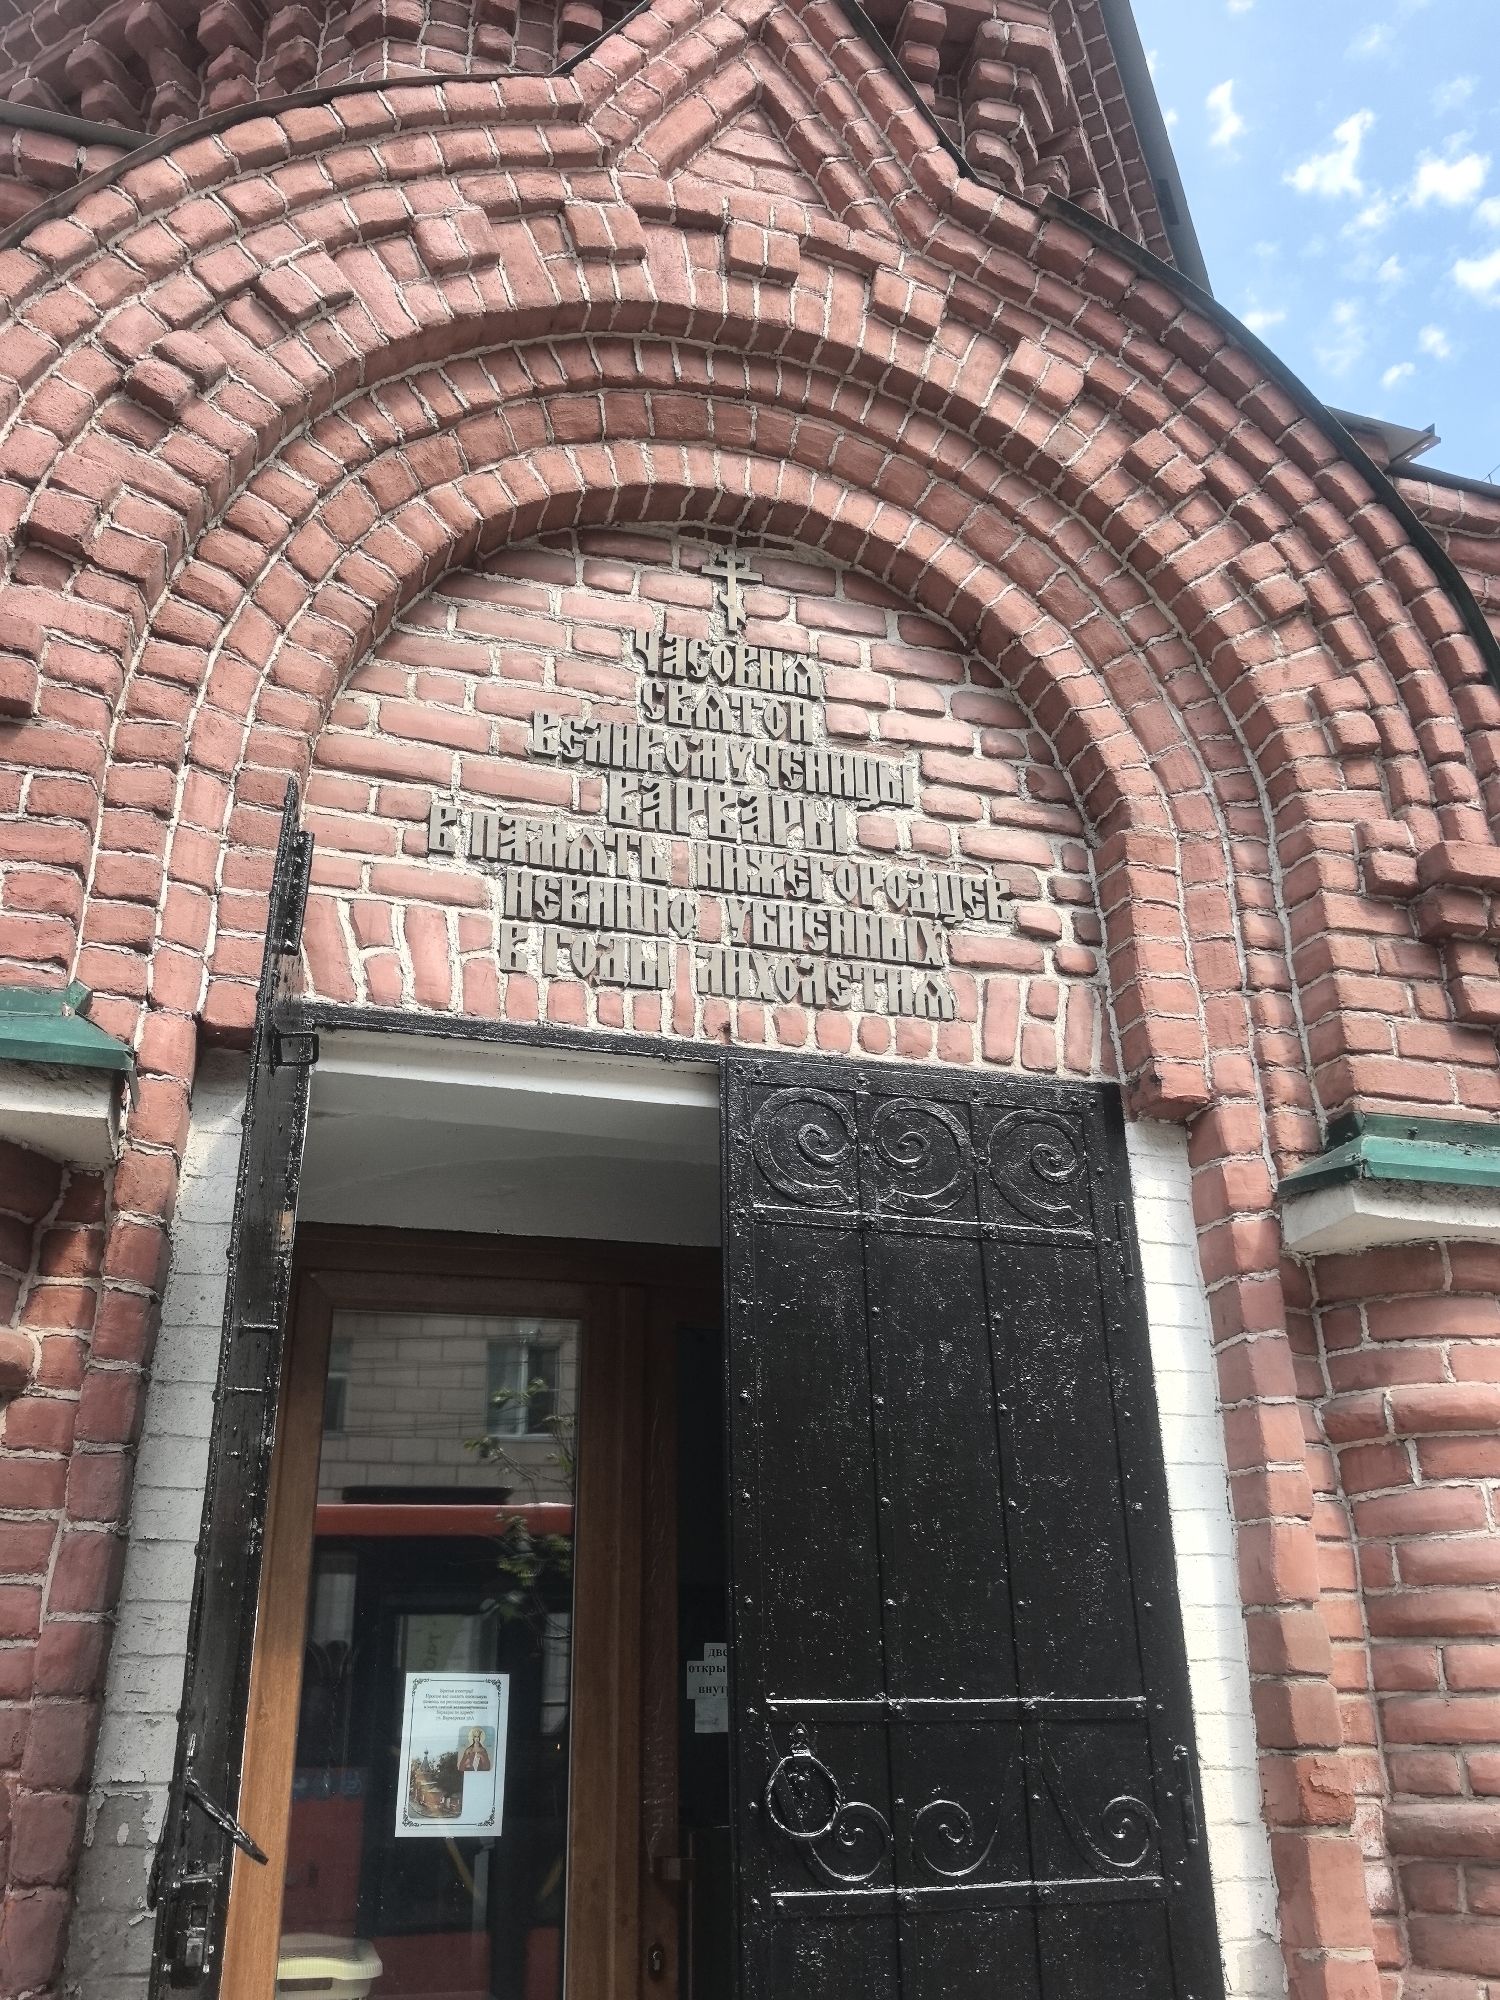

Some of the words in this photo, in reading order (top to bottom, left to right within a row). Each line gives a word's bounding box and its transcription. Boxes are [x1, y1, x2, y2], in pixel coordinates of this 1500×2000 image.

[429, 804, 458, 853] В
[608, 771, 848, 855] ВАРВАРЫ
[504, 869, 695, 938] НЕВИННО
[499, 924, 529, 972] В
[543, 927, 670, 989] ГОДЫ
